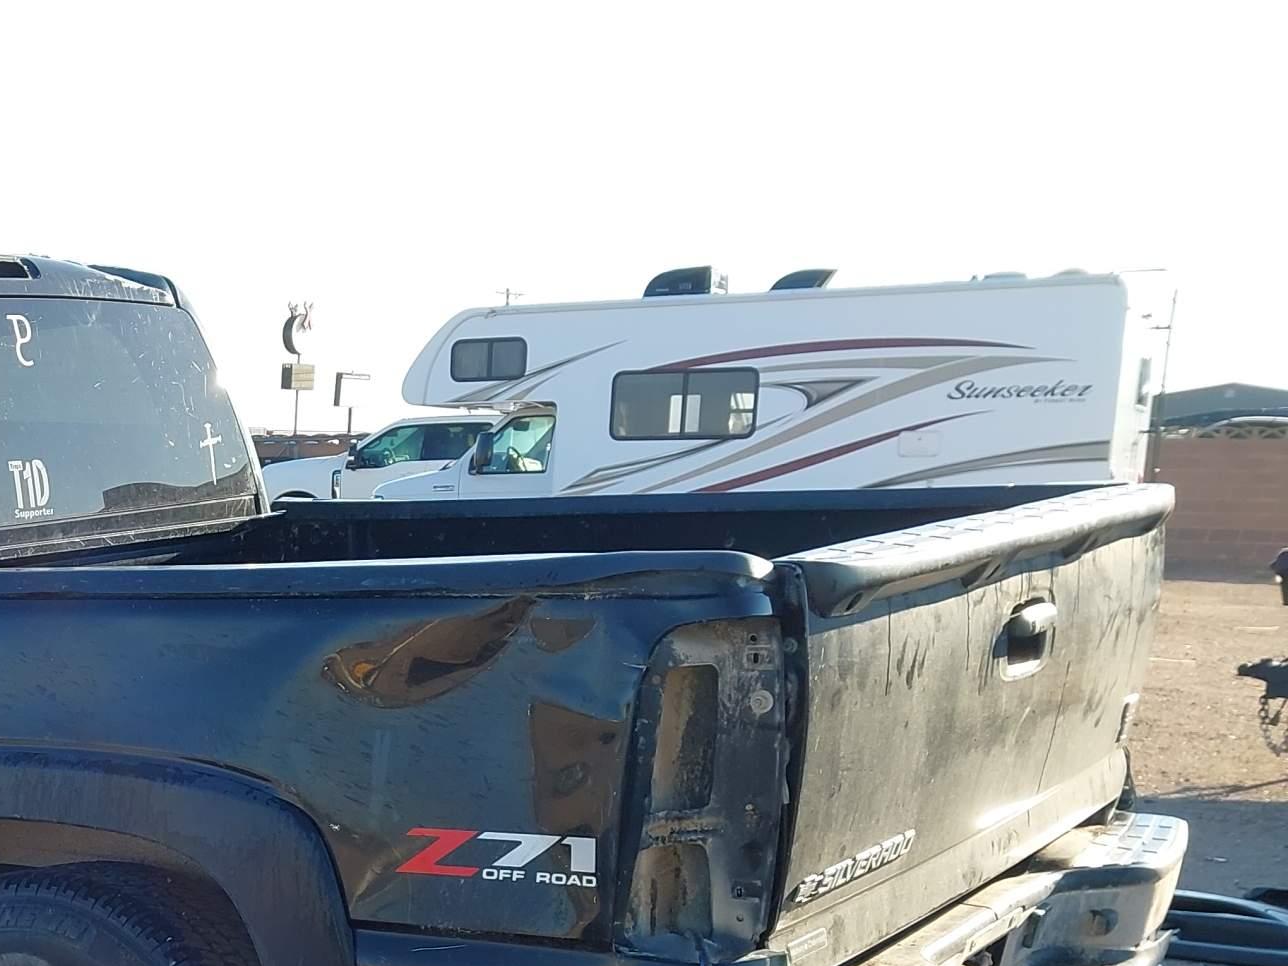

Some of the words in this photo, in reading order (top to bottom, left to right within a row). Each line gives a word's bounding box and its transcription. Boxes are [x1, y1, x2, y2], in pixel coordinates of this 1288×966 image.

[946, 379, 1093, 400] Sunseeker
[8, 459, 50, 509] T1D
[14, 508, 54, 520] Supporter
[395, 827, 597, 877] Z71
[817, 828, 916, 894] SILVERADO
[481, 868, 526, 882] OFF
[535, 872, 597, 888] ROAD
